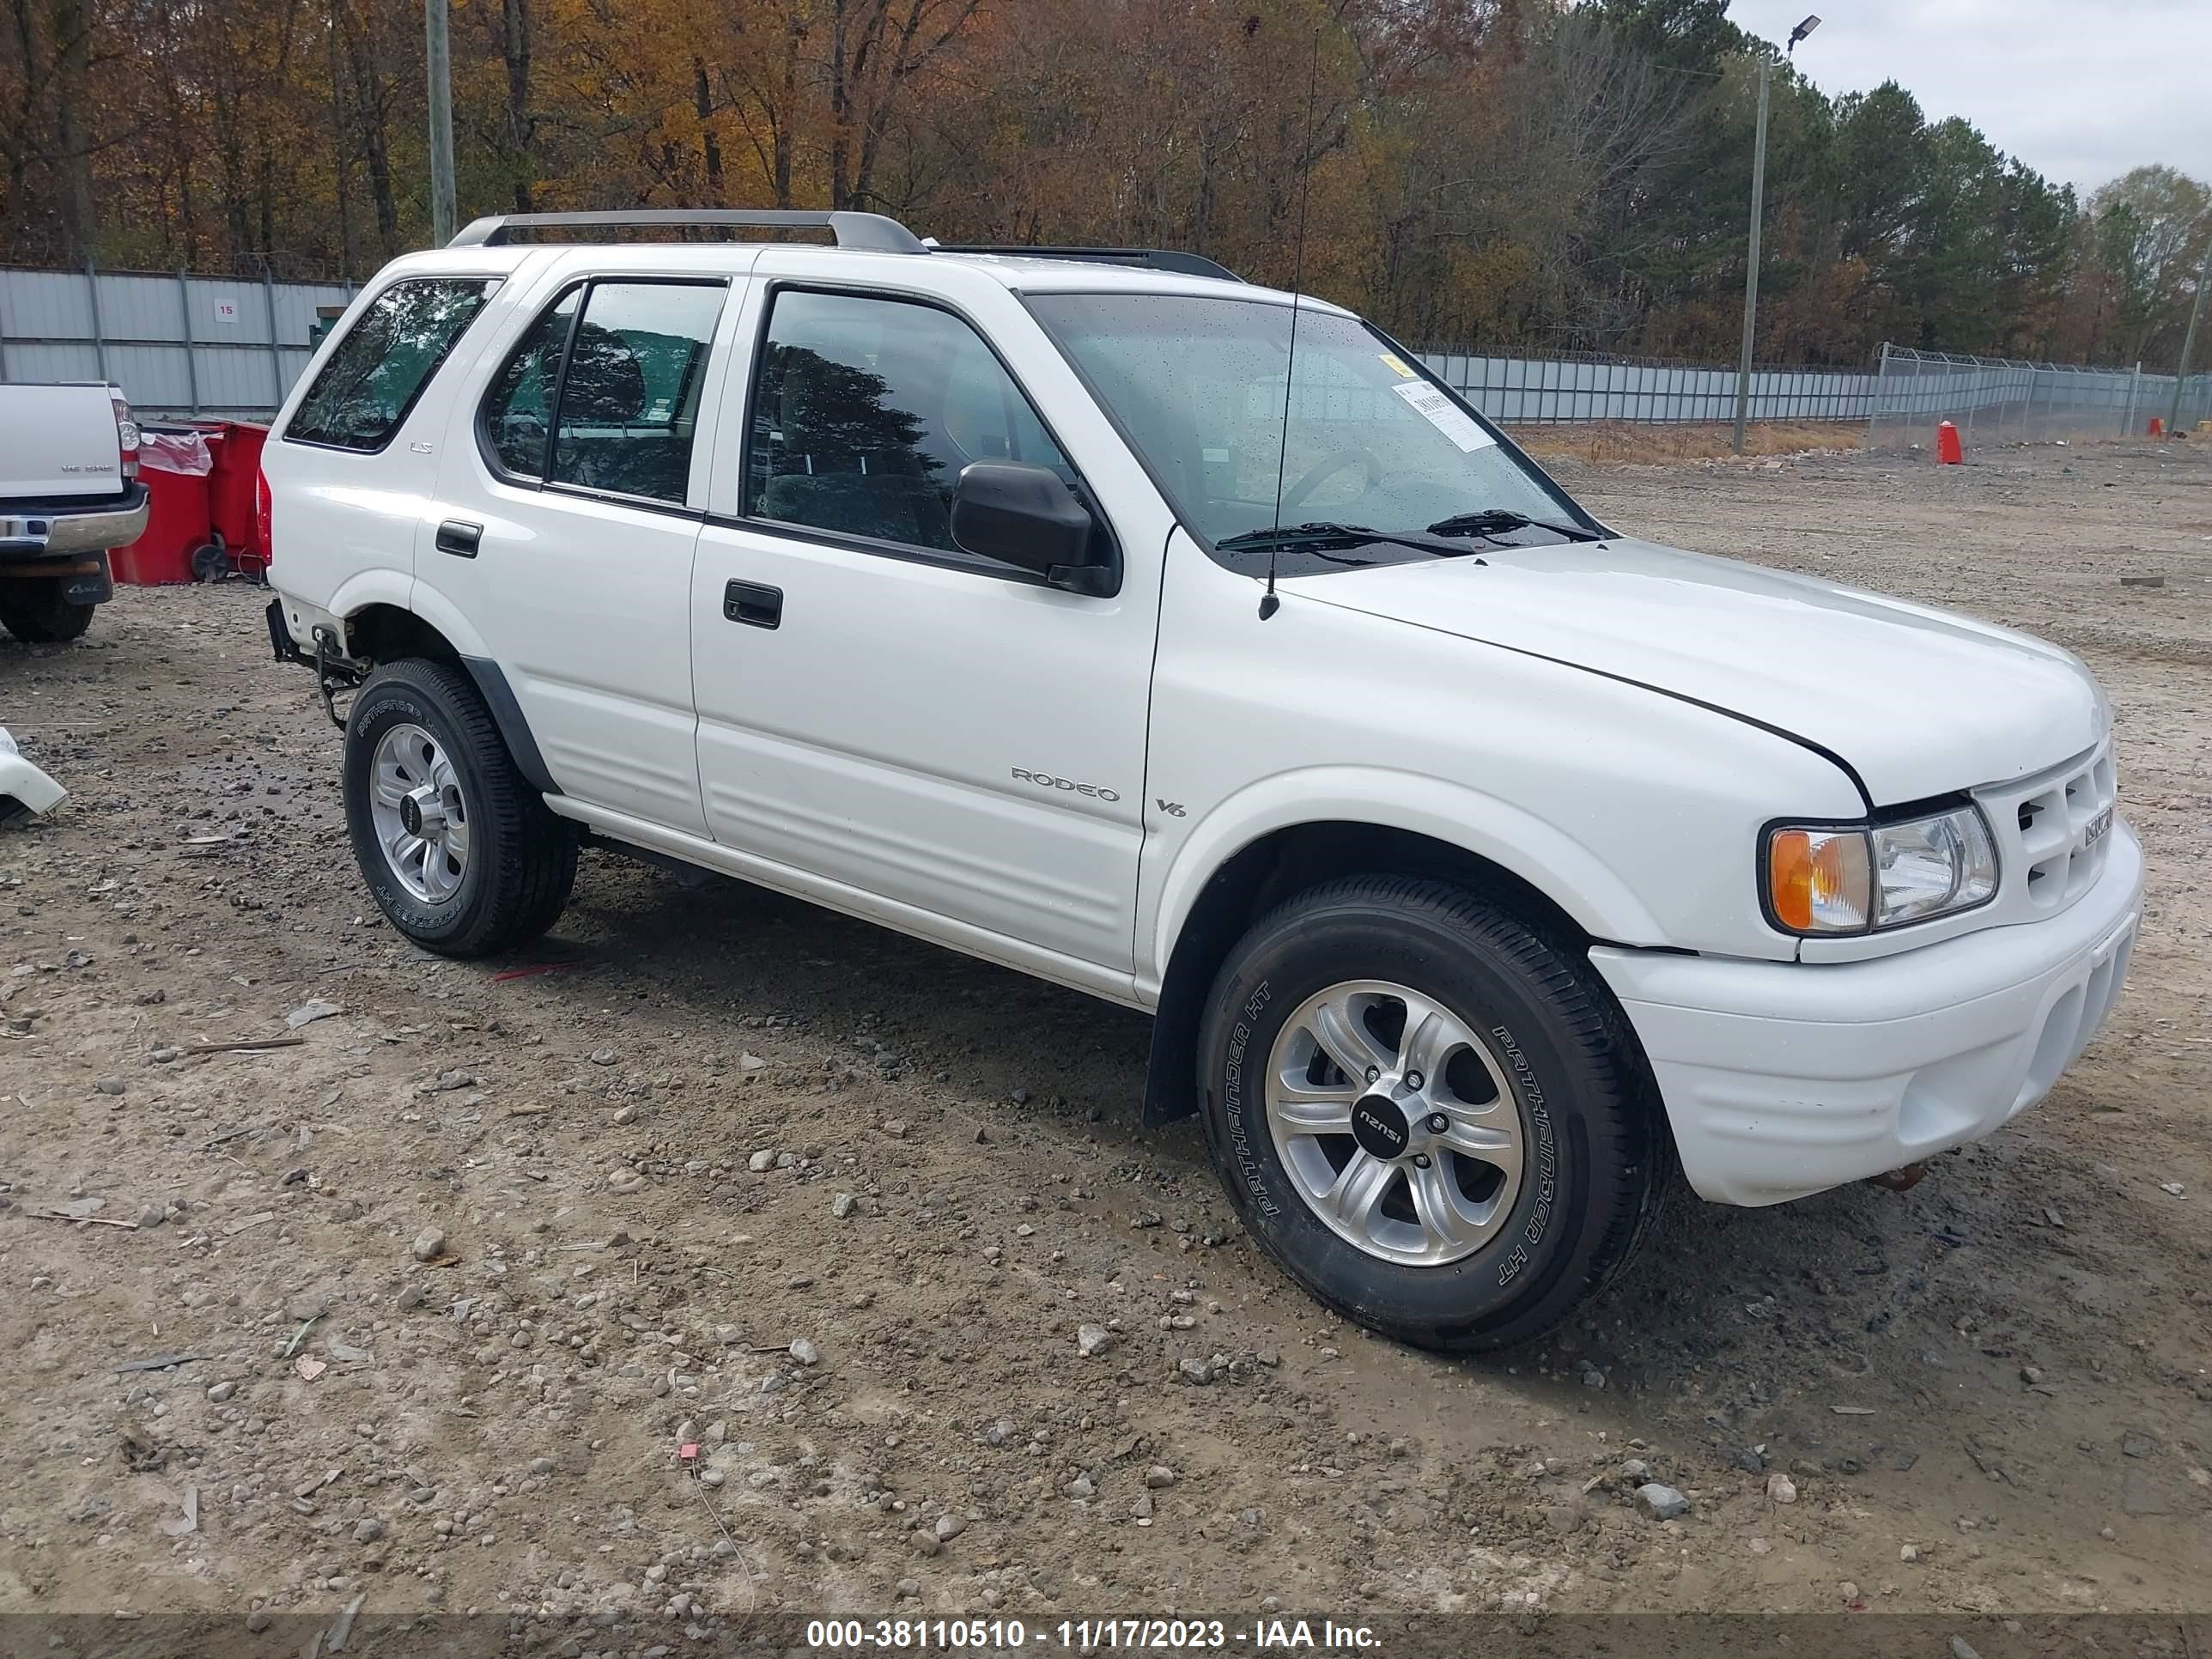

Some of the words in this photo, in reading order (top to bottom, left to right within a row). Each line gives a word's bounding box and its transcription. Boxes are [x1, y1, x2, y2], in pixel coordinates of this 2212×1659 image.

[220, 306, 234, 314] 15
[410, 440, 434, 454] LS
[1011, 765, 1121, 802] RODEO
[1155, 798, 1187, 817] V6
[1245, 980, 1271, 1021] HT
[1225, 1023, 1280, 1217] PATHFINDER
[1359, 1110, 1401, 1145] ISUZU
[1492, 1025, 1555, 1244] PATHFINDER
[1498, 1244, 1528, 1286] HT
